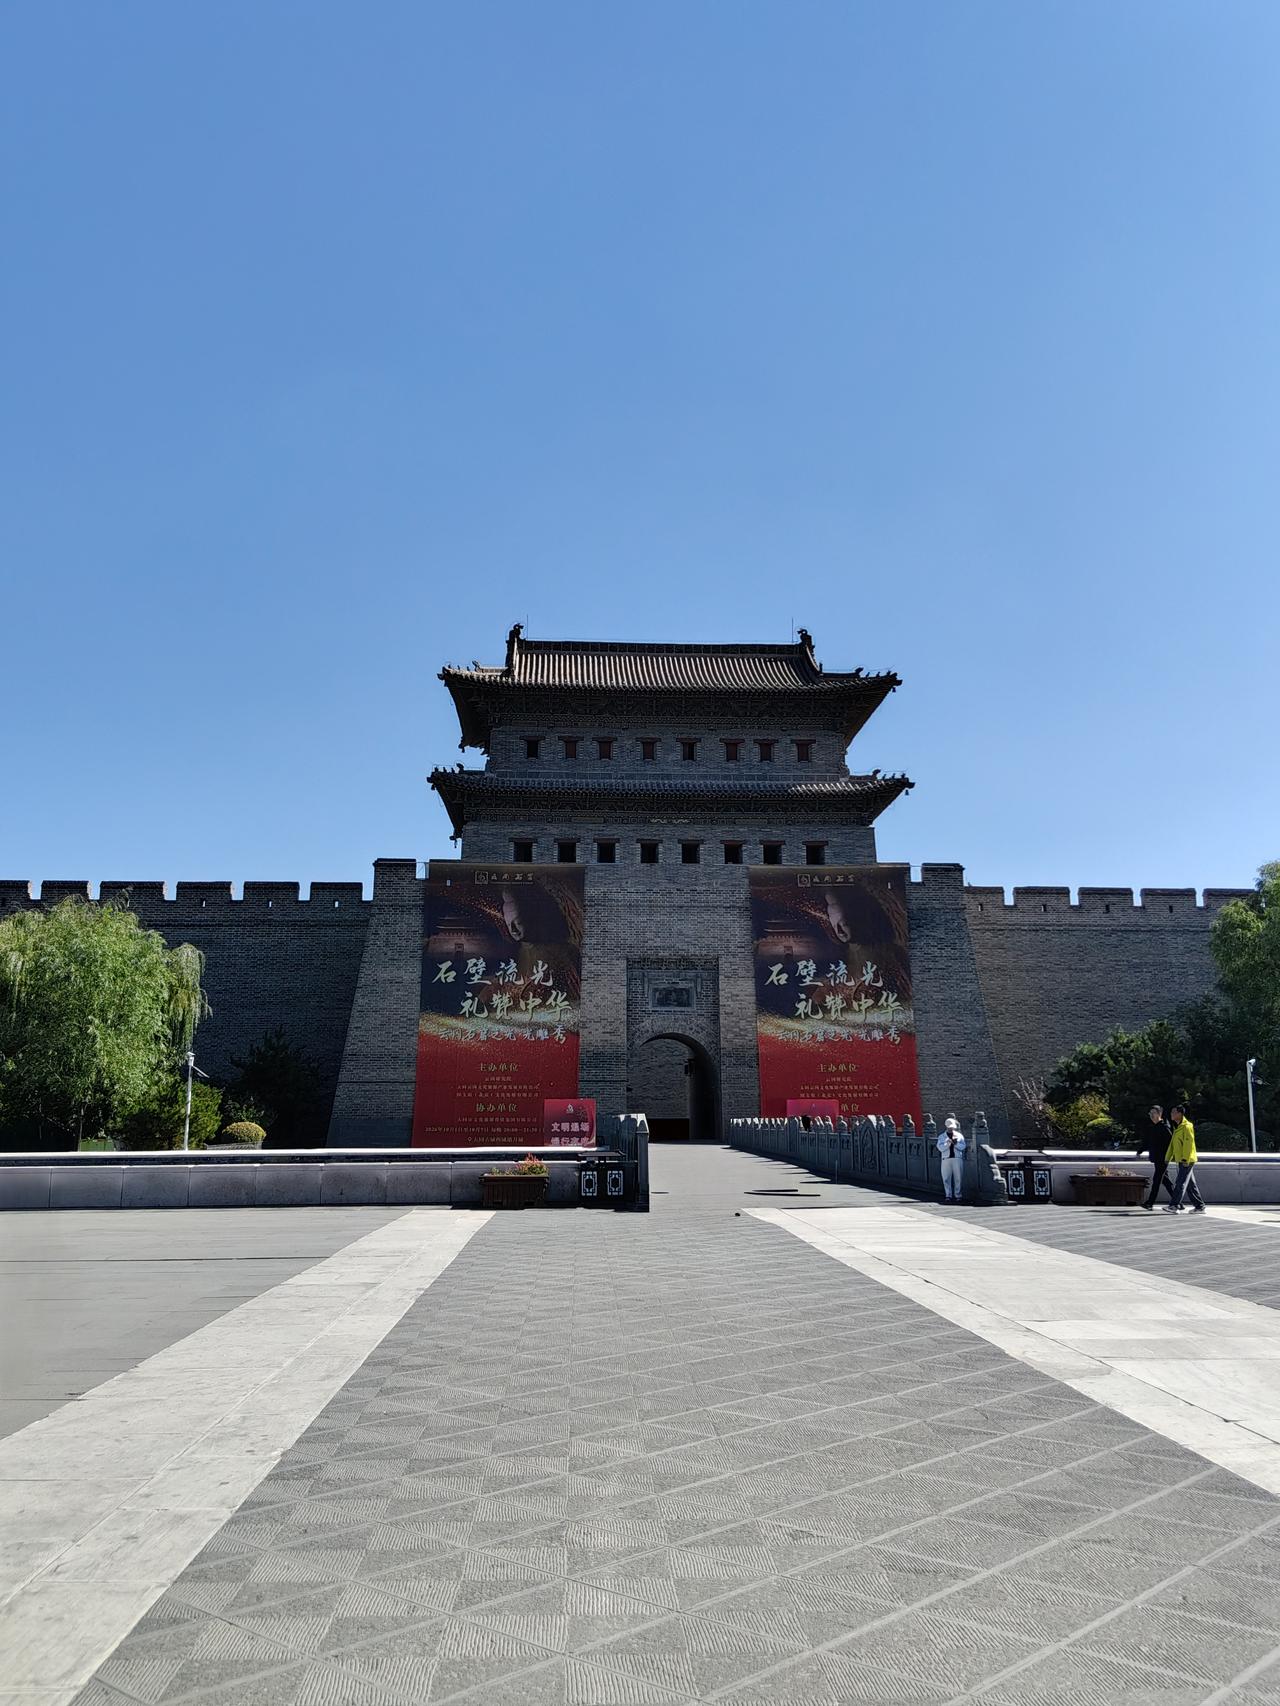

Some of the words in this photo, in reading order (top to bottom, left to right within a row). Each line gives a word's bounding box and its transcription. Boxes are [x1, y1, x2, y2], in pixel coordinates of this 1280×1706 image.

[432, 956, 553, 987] 石壁流光
[764, 958, 884, 988] 石壁流光
[480, 1062, 519, 1072] 主办单位
[817, 1063, 857, 1072] 主办单位
[476, 1103, 517, 1112] 协办单位
